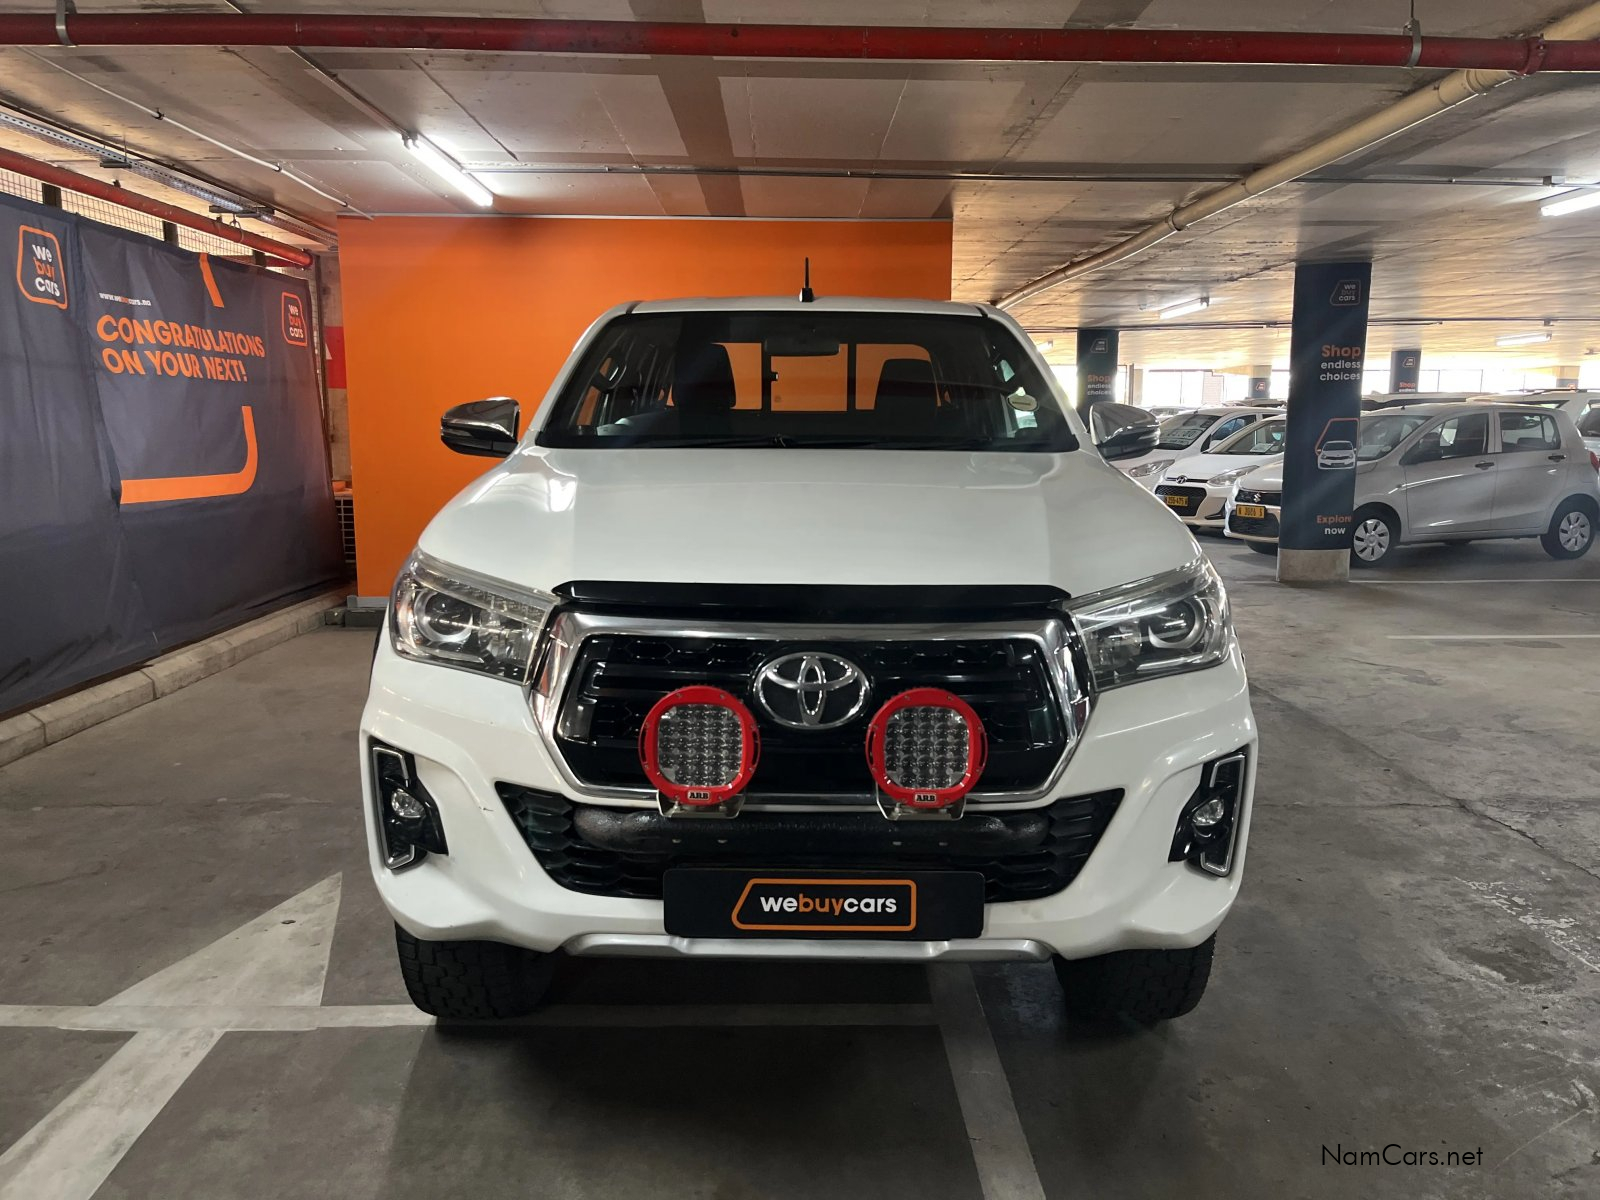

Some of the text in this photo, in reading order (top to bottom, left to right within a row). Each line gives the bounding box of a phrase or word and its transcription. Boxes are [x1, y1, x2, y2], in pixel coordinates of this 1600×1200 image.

[32, 244, 53, 263] we
[35, 277, 60, 297] cars
[96, 314, 266, 358] CONGRATULATIONS
[289, 326, 304, 339] cars
[1321, 344, 1361, 359] Shop
[102, 347, 248, 382] ON YOUR NEXT!
[1320, 360, 1361, 370] endless
[1087, 374, 1111, 383] Shop
[1319, 371, 1361, 381] choices
[1324, 527, 1346, 535] now
[688, 791, 709, 800] ARB
[915, 793, 937, 802] ARB
[760, 893, 897, 916] webuycars
